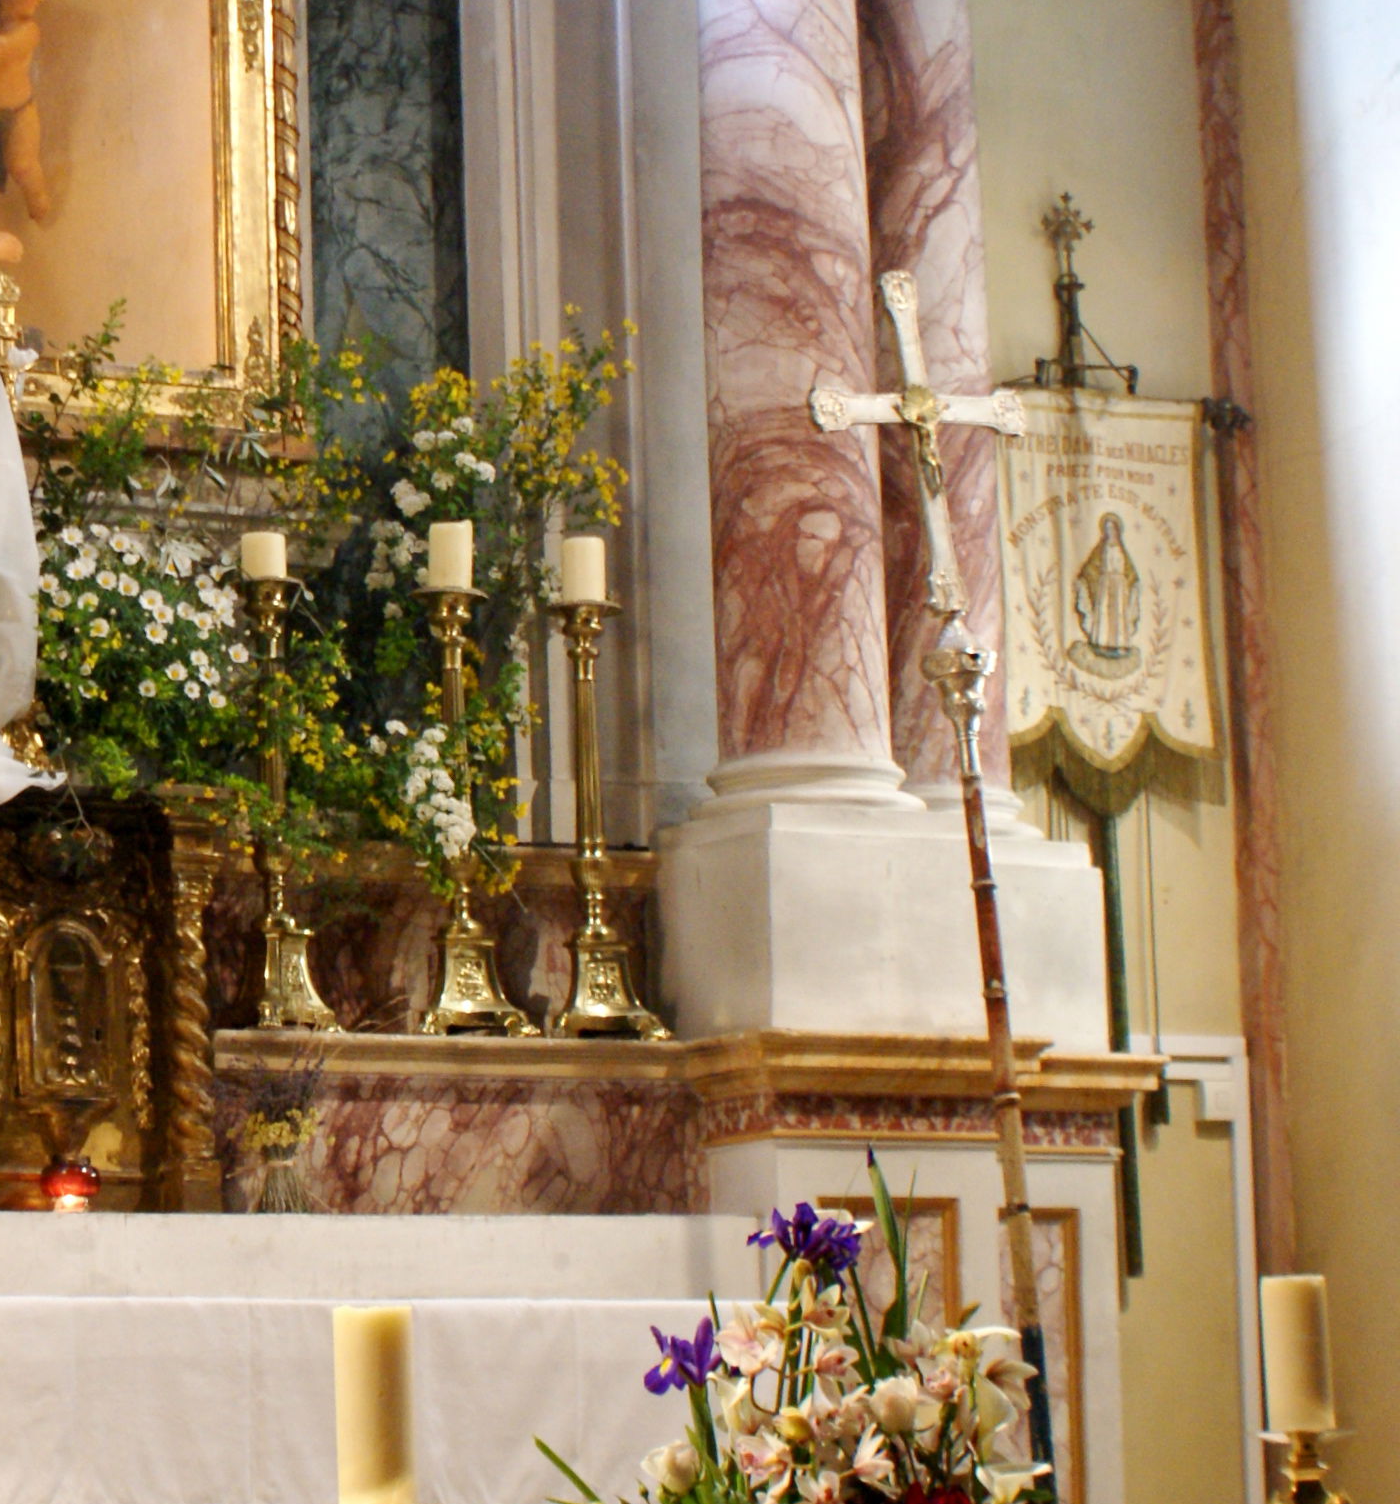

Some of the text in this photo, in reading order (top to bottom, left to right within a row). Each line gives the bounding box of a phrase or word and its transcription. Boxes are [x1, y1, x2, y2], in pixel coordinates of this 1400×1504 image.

[1061, 435, 1102, 456] DAME
[1124, 442, 1189, 465] MIRACLES
[1046, 464, 1155, 485] PRIEZ POUR NOUS
[1007, 491, 1079, 548] MONSTRA
[1080, 484, 1103, 500] TE
